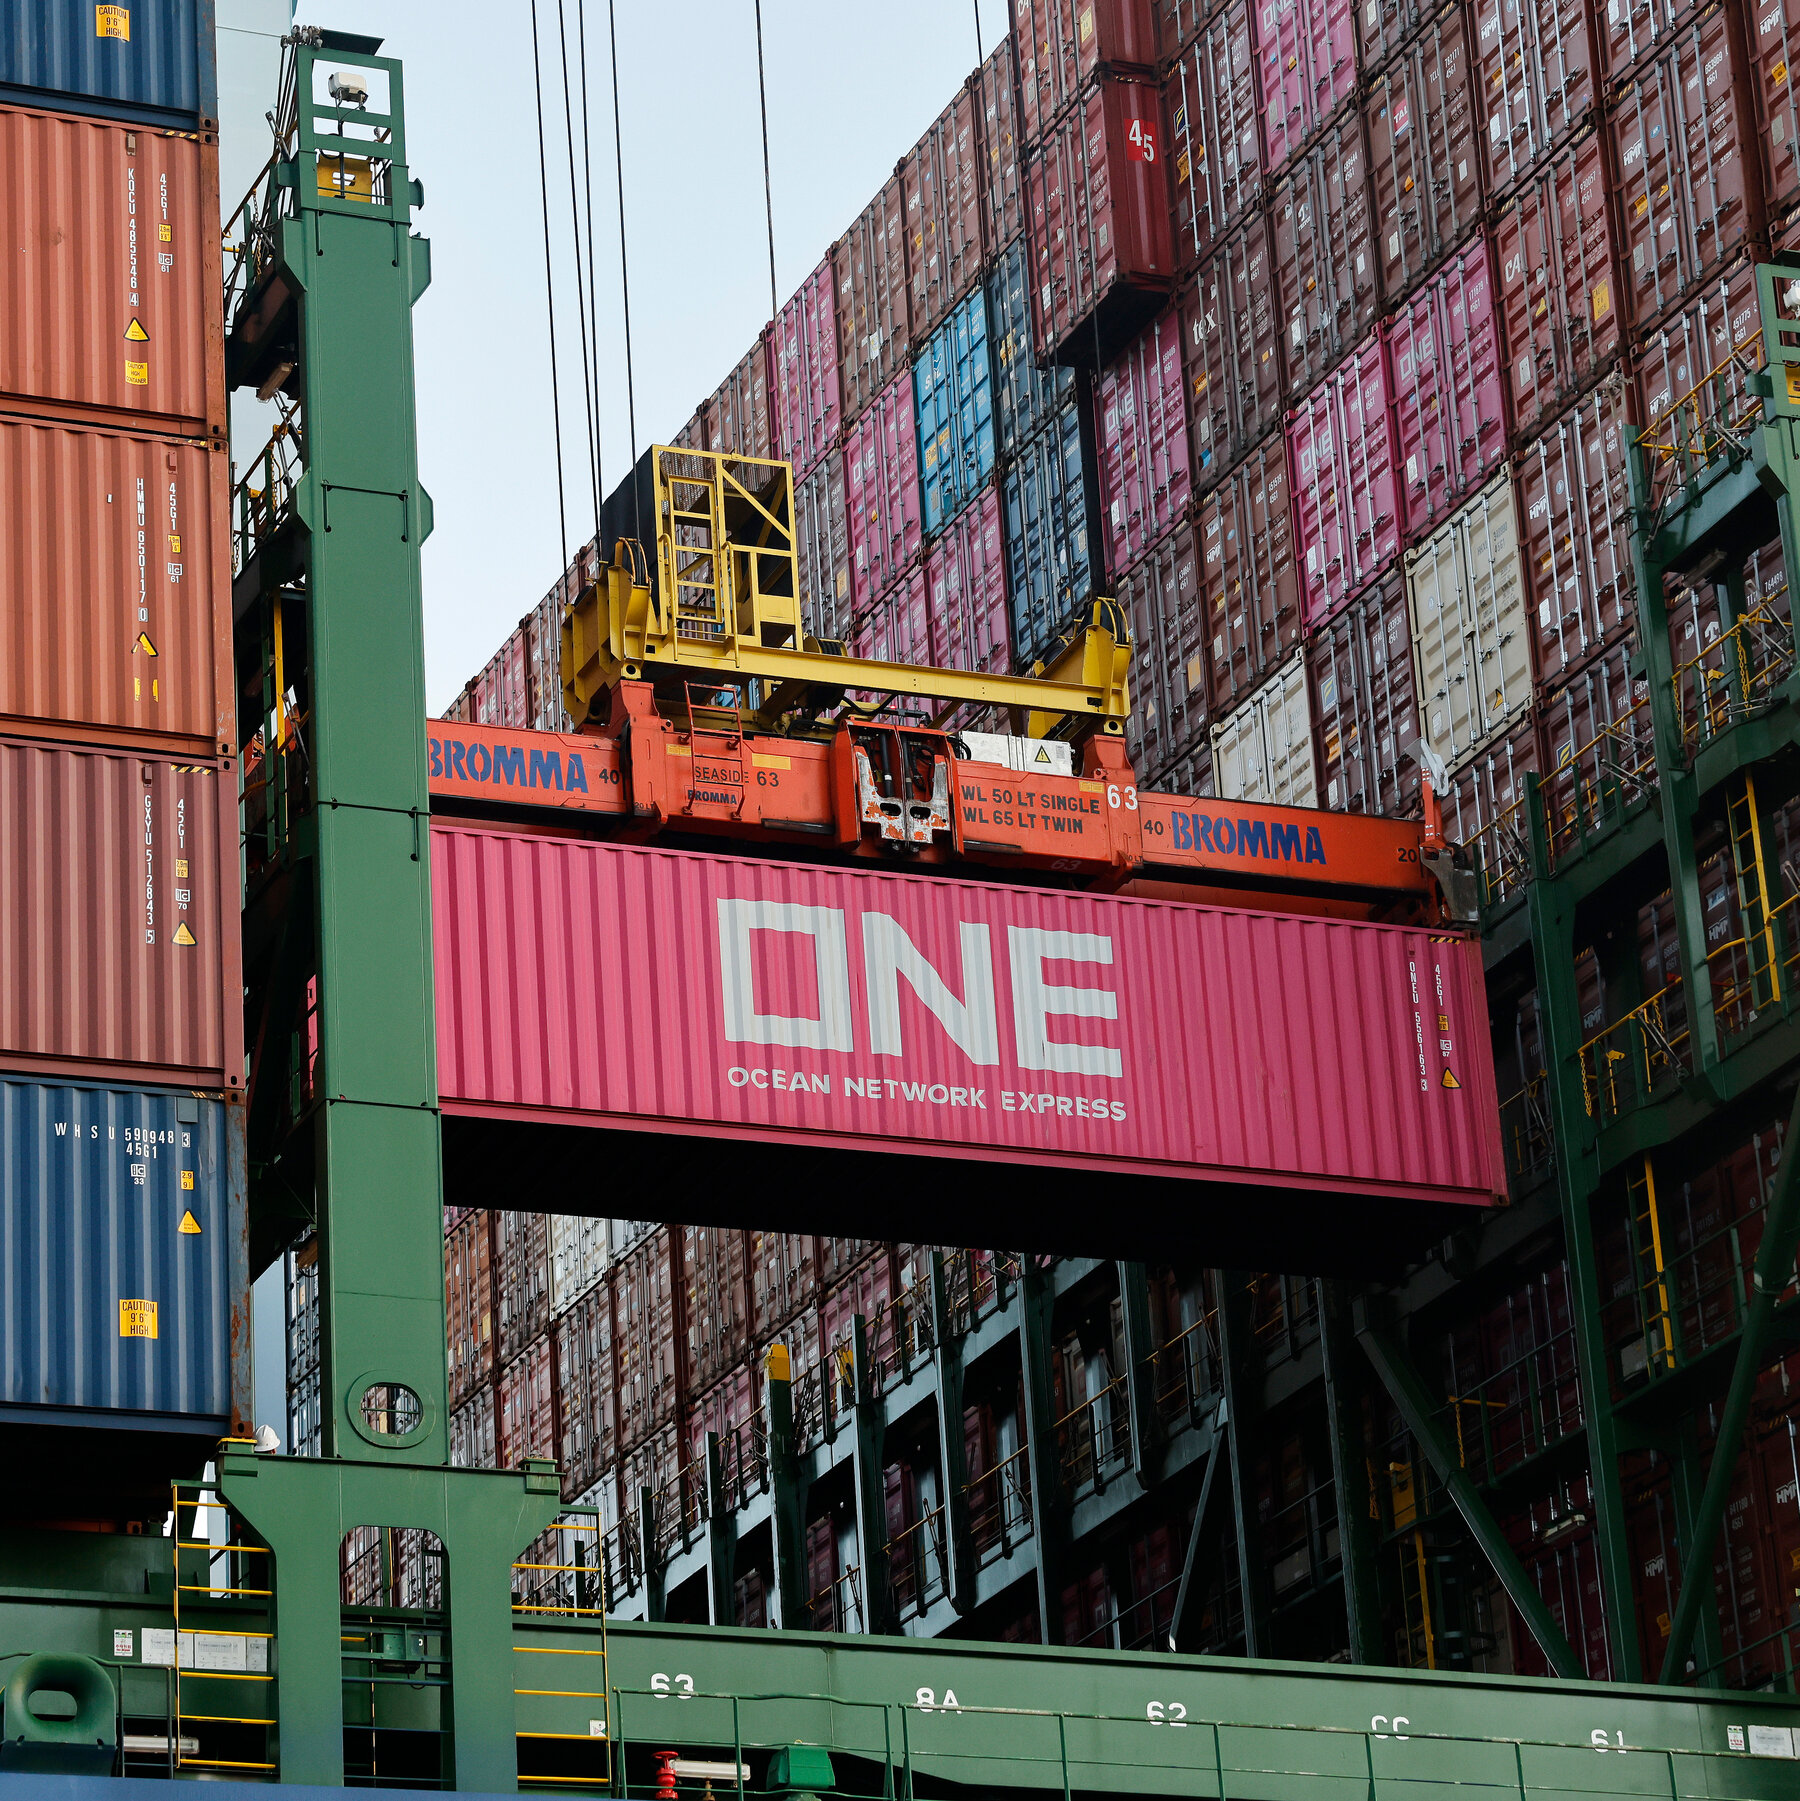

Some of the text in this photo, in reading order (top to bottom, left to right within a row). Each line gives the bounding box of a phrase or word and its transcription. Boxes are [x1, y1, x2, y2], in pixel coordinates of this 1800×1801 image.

[98, 6, 127, 19] CAUTION
[105, 27, 122, 37] HIGH
[1128, 119, 1155, 162] 45
[159, 173, 169, 220] 45G1
[127, 167, 139, 306] KOCU 485546 4
[161, 265, 170, 273] 61
[168, 482, 178, 531] 45G1
[136, 478, 148, 622] HMMU 650117 0
[170, 575, 180, 583] 61
[599, 768, 621, 786] 40
[757, 771, 780, 787] 63
[687, 789, 738, 805] BROMMA
[961, 785, 1101, 815] WL 50 LT SINGLE
[1106, 784, 1139, 812] 63
[177, 798, 185, 849] 45G1
[962, 806, 1084, 835] WL 65 LT TWIN
[1143, 820, 1165, 837] 40
[1171, 811, 1327, 866] BROMMA
[1397, 847, 1417, 864] 20
[144, 795, 155, 945] GXYU 512843 5
[178, 902, 188, 910] 70
[717, 898, 1123, 1078] ONE
[1434, 964, 1444, 1007] 45G1
[1409, 961, 1419, 1004] ONEU
[1415, 1011, 1427, 1075] 556163
[727, 1066, 1127, 1122] OCEAN NETWORK EXPRESS
[124, 1127, 175, 1145] 590948
[182, 1132, 190, 1148] 3
[126, 1142, 158, 1159] 45G1
[134, 1177, 145, 1186] 33
[121, 1301, 155, 1314] CAUTION
[130, 1323, 150, 1335] HIGH
[650, 1672, 695, 1700] 63
[915, 1686, 963, 1715] 8A
[1146, 1700, 1188, 1728] 62
[1590, 1728, 1628, 1754] 61
